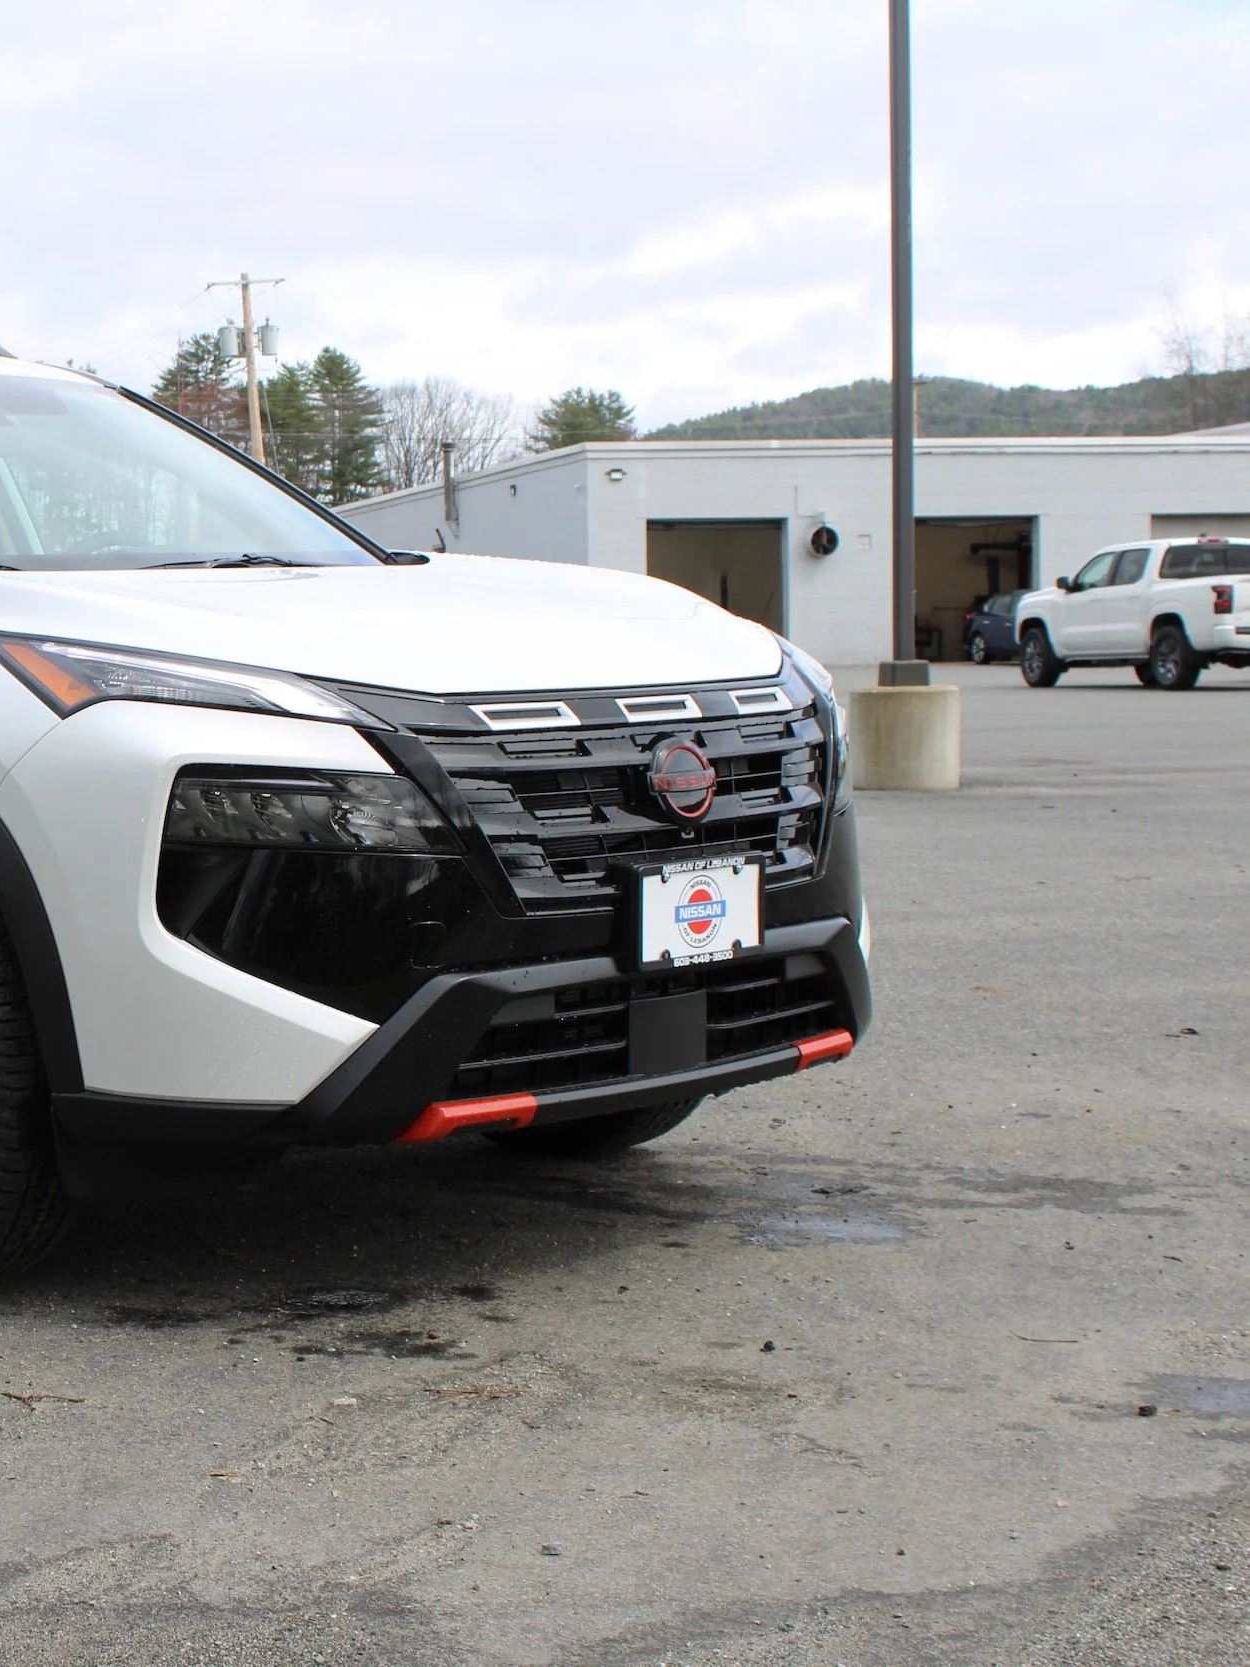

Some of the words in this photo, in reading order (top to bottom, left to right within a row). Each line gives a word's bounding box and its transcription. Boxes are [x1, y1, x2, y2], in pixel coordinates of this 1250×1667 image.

[654, 774, 715, 790] NISSAN
[662, 862, 694, 874] NISSAN
[694, 861, 706, 870] OF
[706, 856, 746, 868] LEBANON
[690, 880, 712, 889] NISSAN
[679, 903, 721, 920] NISSAN
[673, 950, 734, 968] 603-448-3500
